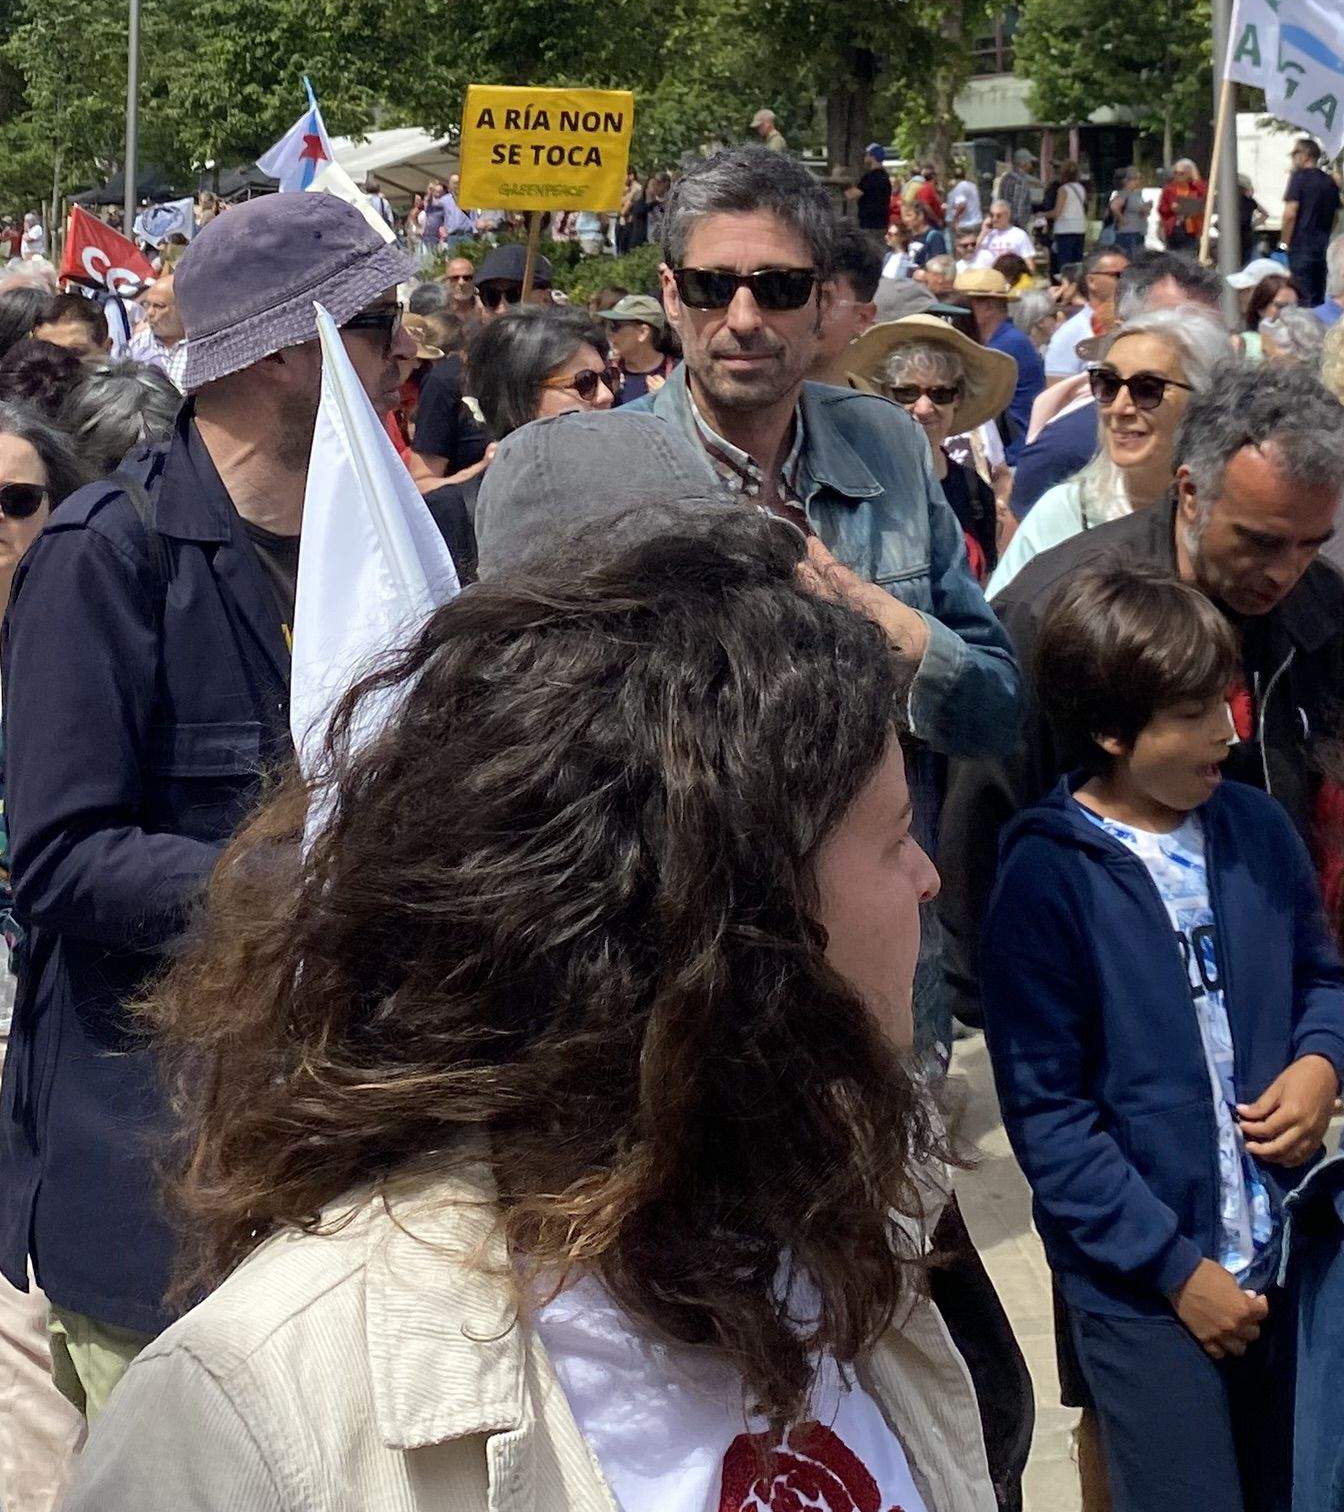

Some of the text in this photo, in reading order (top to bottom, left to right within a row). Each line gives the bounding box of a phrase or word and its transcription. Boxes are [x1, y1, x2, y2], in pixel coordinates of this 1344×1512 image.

[476, 103, 624, 132] A RÍA NON
[491, 144, 602, 167] SE TOCA
